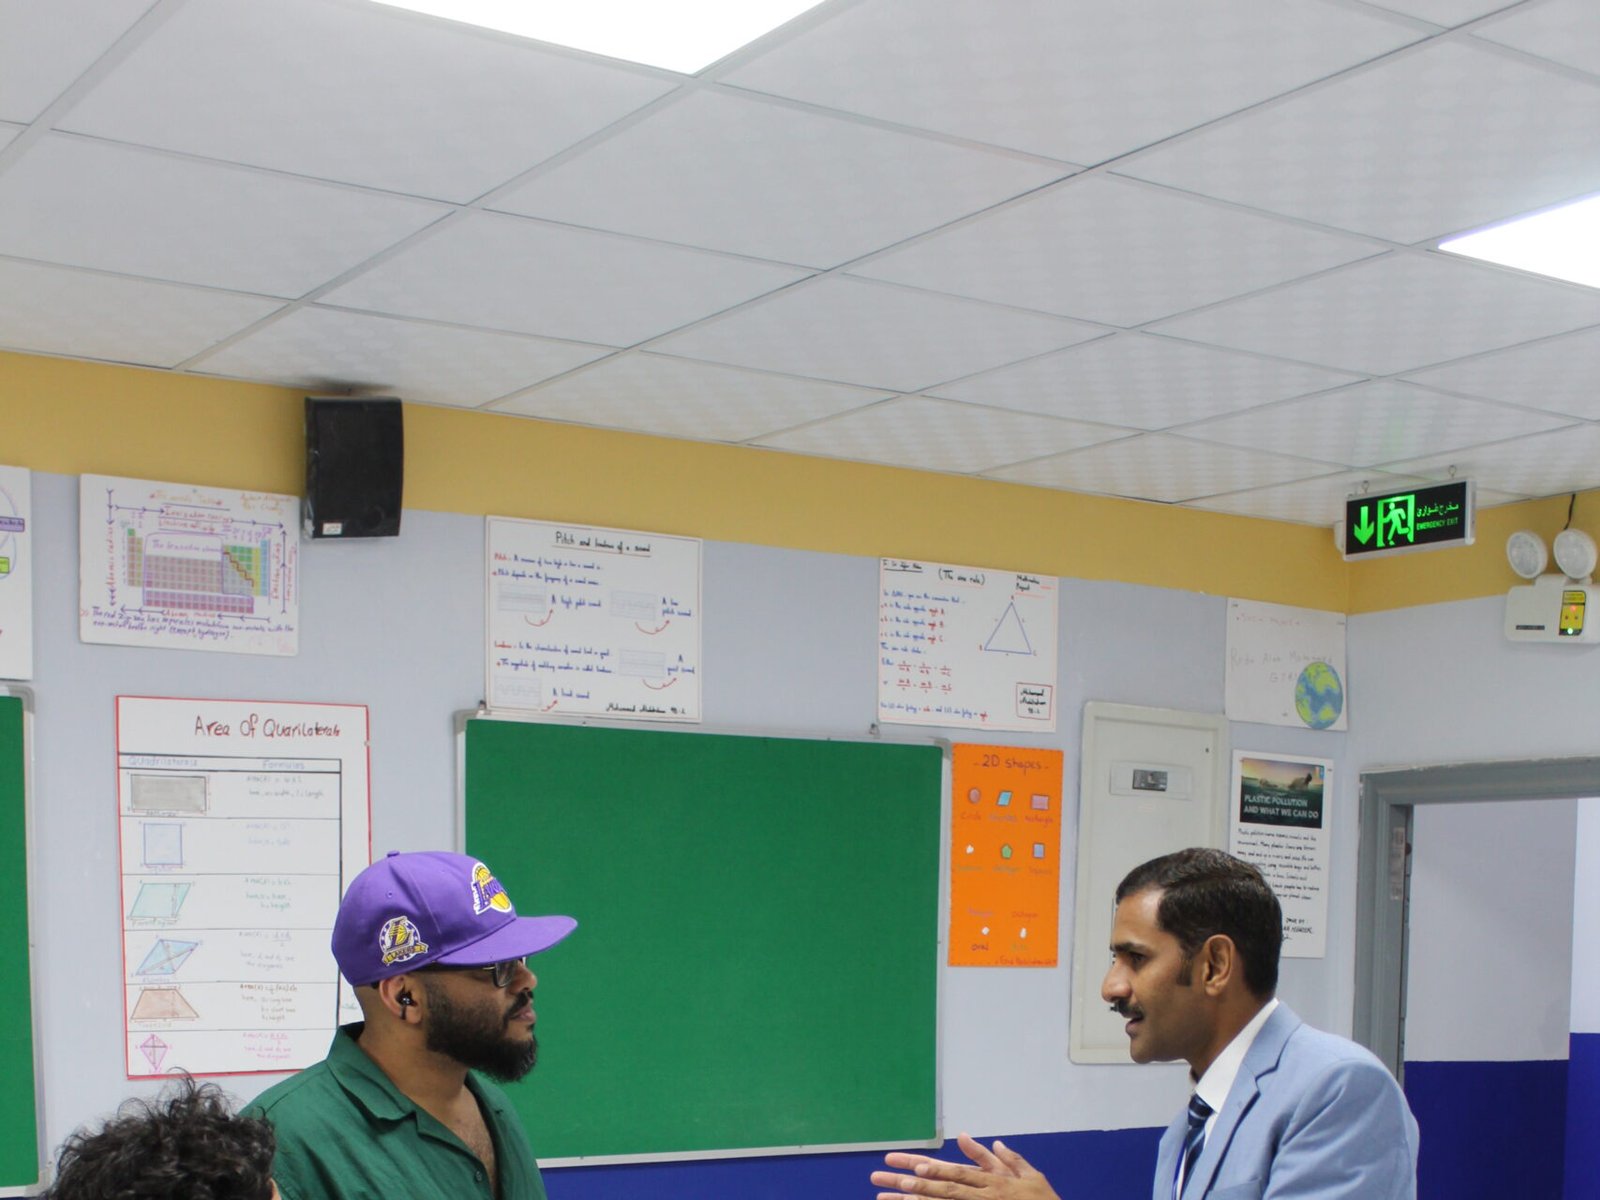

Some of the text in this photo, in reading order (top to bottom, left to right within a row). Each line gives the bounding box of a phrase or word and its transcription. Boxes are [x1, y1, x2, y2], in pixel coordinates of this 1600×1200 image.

[1417, 517, 1458, 530] EMERGENCY EXIT
[556, 531, 575, 544] Pitch
[195, 716, 230, 737] Area
[240, 713, 258, 739] Of
[982, 754, 1042, 776] 2D shapes
[1244, 794, 1308, 807] PLASTIC POLLUTION
[1260, 807, 1279, 815] WHAT
[1293, 810, 1307, 818] CAN
